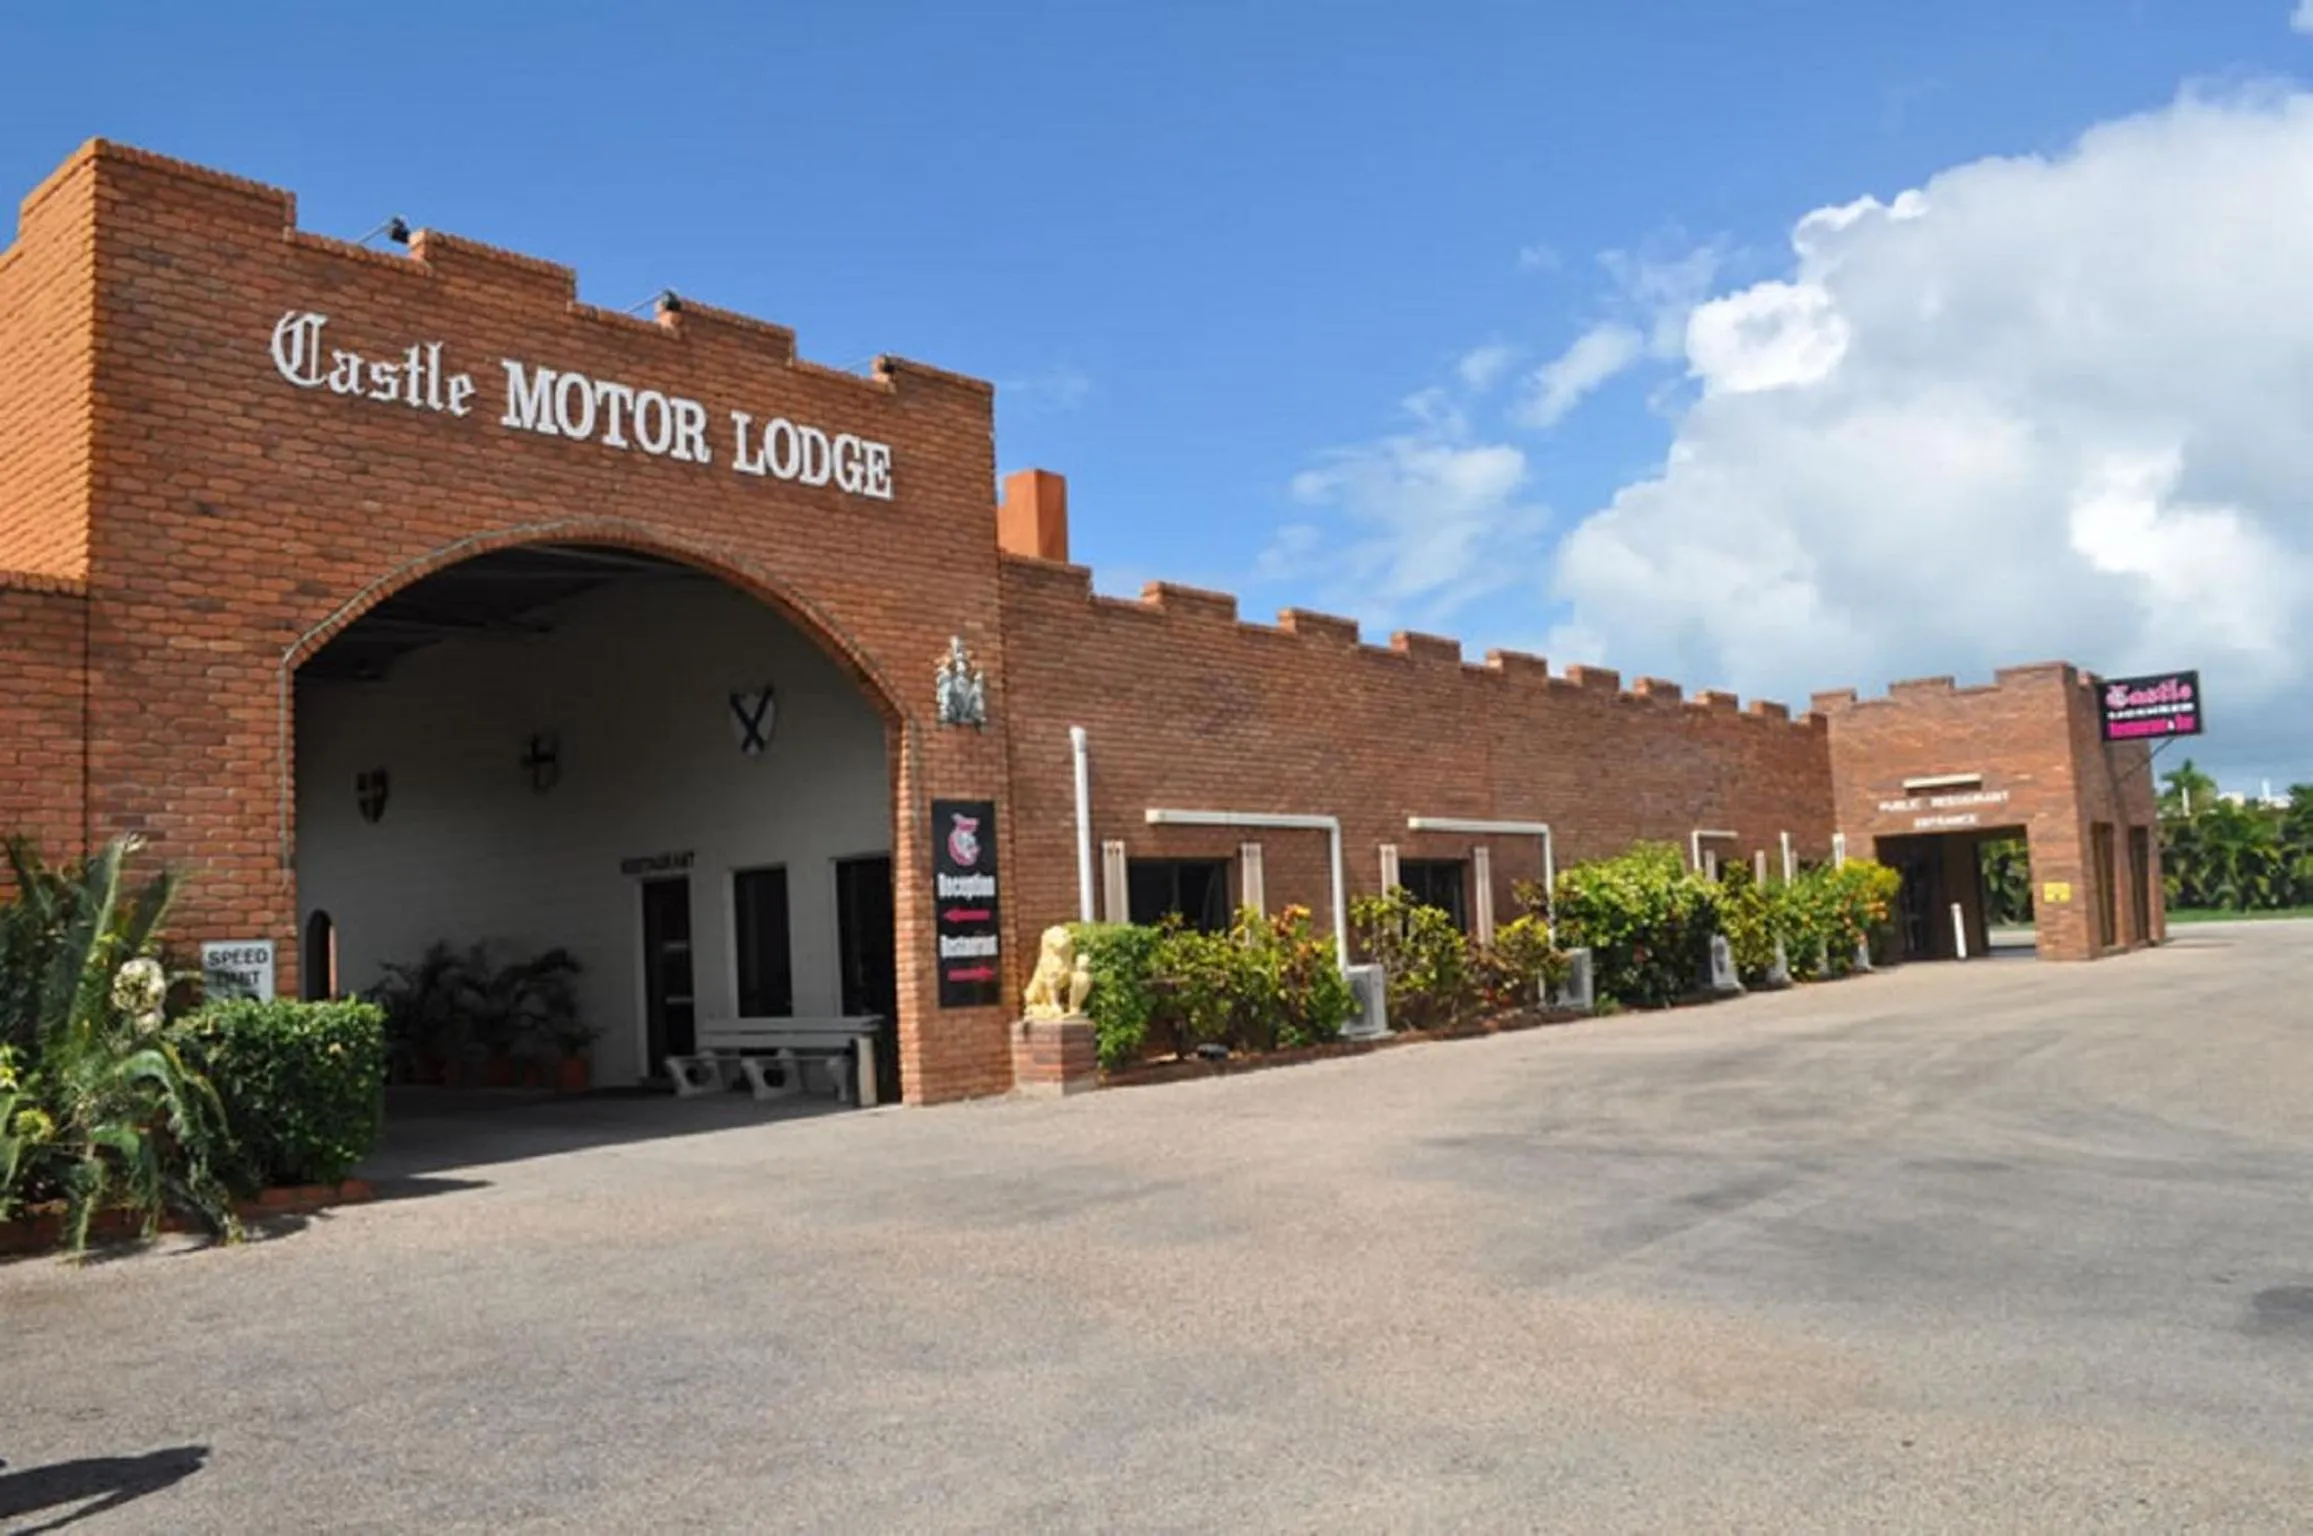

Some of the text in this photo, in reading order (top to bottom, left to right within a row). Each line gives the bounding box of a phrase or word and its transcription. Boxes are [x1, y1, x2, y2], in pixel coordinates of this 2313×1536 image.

[270, 308, 894, 500] Castle MOTOR LODGE
[208, 947, 268, 967] SPEED
